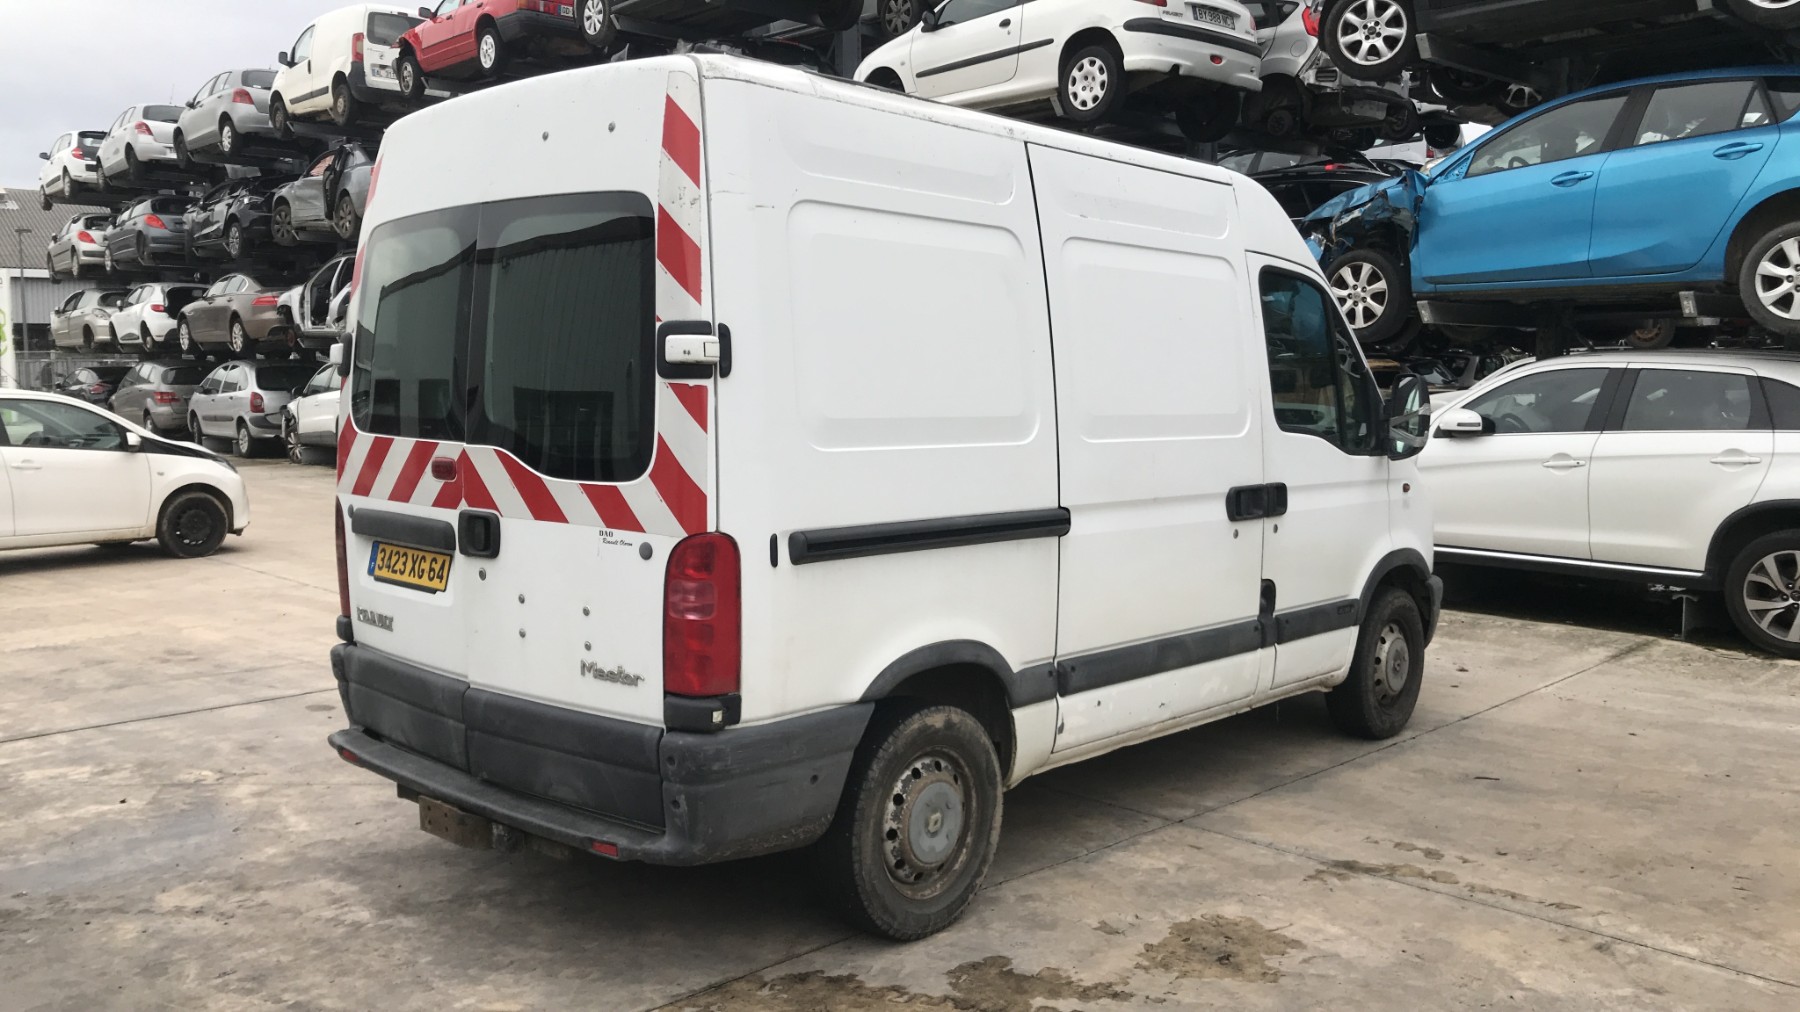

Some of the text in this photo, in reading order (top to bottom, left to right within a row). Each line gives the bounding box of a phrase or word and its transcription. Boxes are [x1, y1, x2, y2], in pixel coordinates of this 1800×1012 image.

[377, 547, 446, 584] 3423 XG 64
[580, 659, 645, 687] Master
